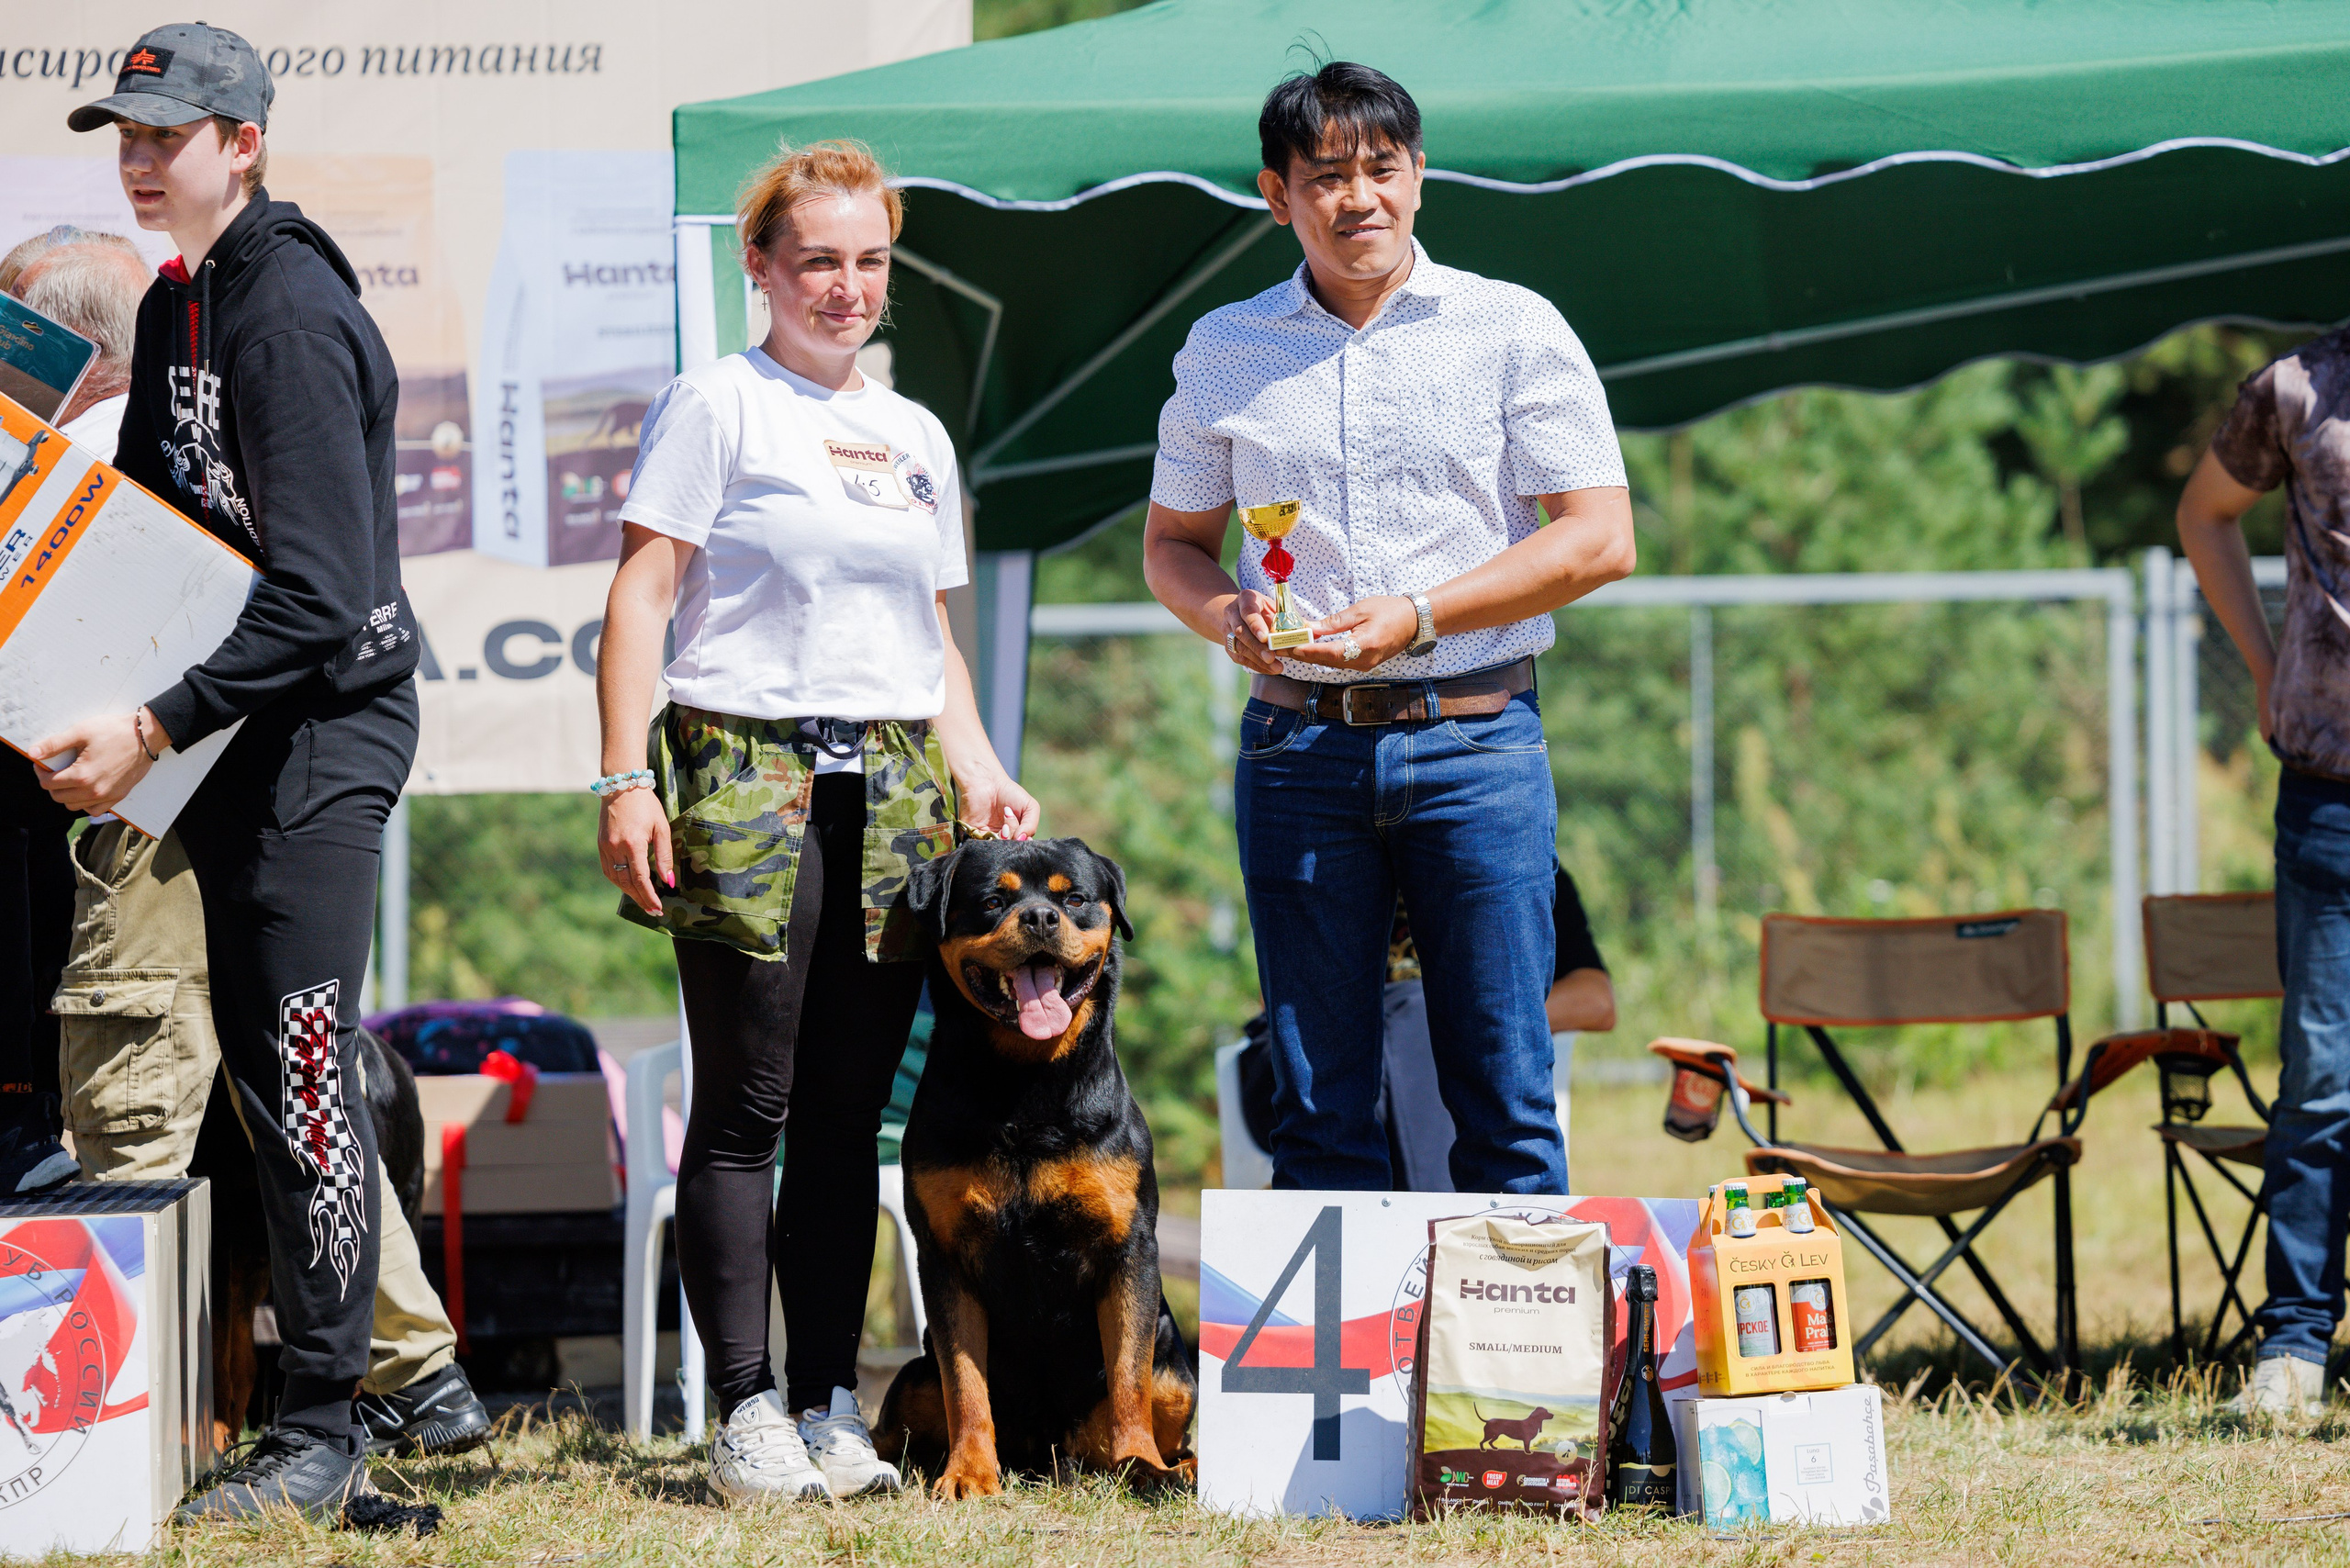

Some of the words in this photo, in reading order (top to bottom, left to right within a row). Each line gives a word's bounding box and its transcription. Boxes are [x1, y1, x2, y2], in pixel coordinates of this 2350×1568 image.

[361, 43, 603, 75] питания
[356, 263, 419, 286] nta
[500, 380, 520, 540] Hanta
[828, 445, 889, 463] Hanta
[894, 453, 911, 471] WEILER
[20, 472, 105, 588] 1400W
[1484, 1253, 1526, 1263] говядиной
[1533, 1258, 1559, 1266] рисом
[1729, 1257, 1776, 1272] ČESKY
[1800, 1253, 1829, 1267] LEV
[1460, 1278, 1576, 1305] Hanta
[1494, 1306, 1540, 1315] premium
[1807, 1312, 1833, 1327] Mala
[1222, 1205, 1371, 1462] 4
[1469, 1341, 1562, 1354] SMALL/MEDIUM
[54, 1287, 101, 1436] РОССИИ
[1772, 1361, 1815, 1370] БЛАГОРОДСТВО
[1810, 1455, 1817, 1463] 6
